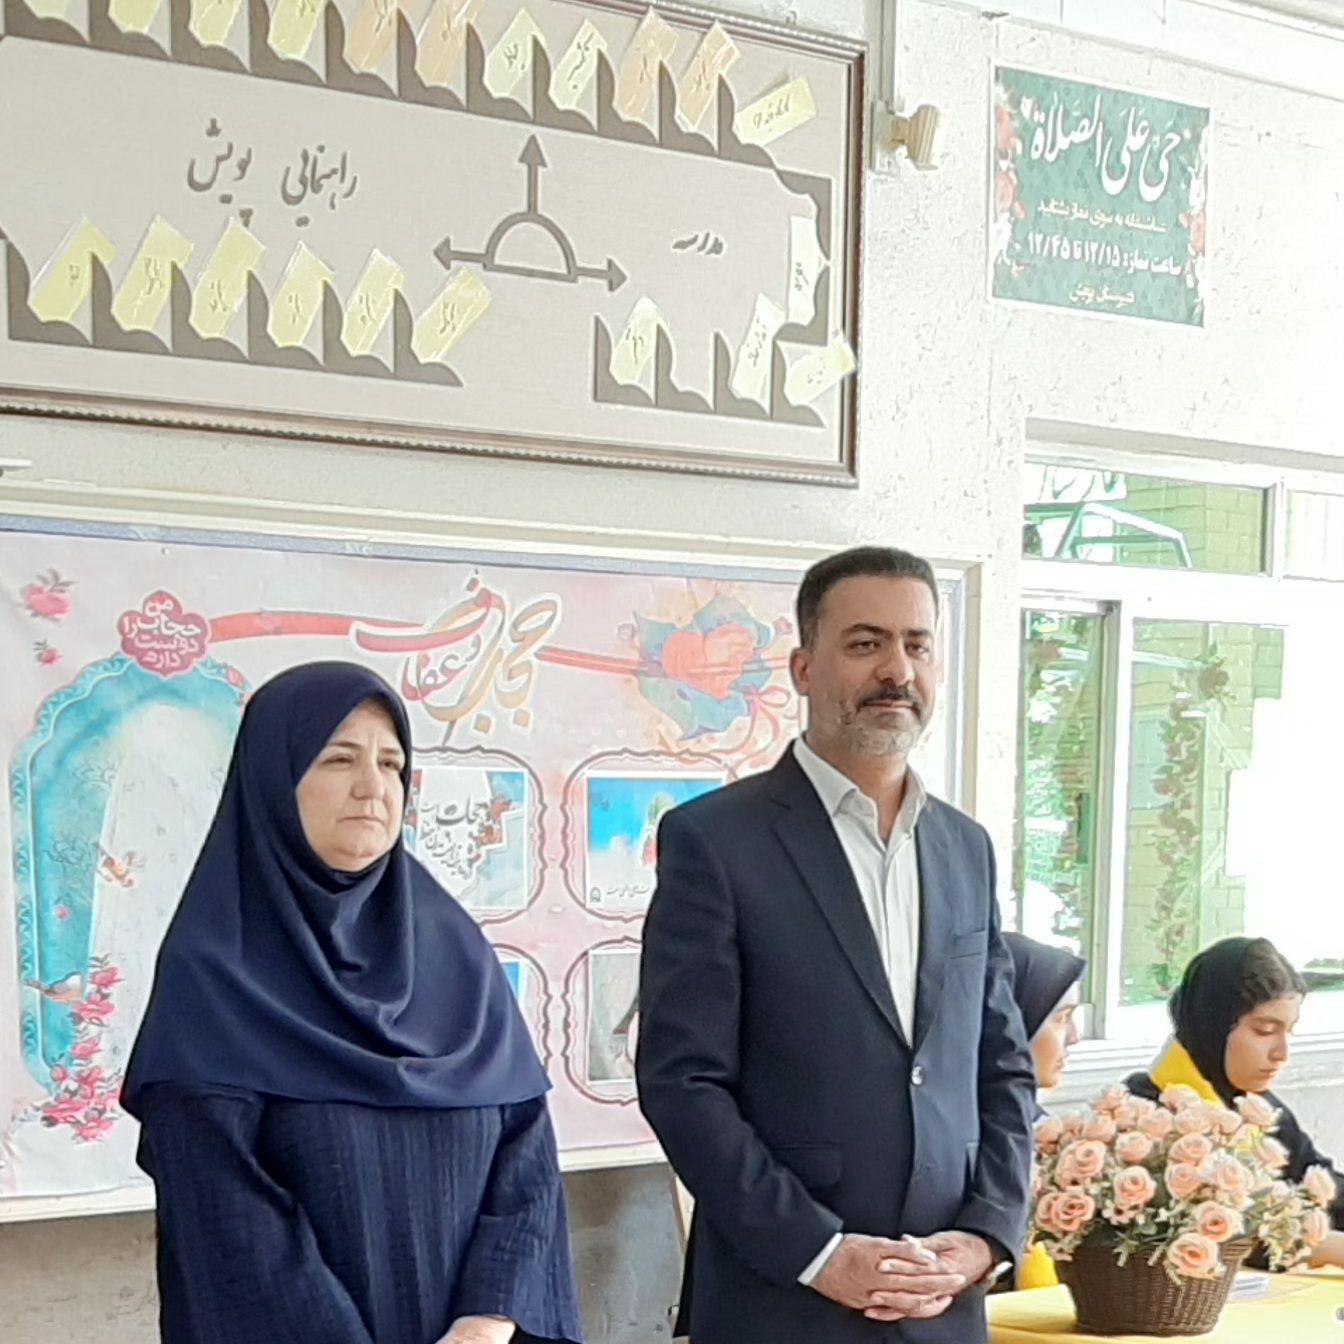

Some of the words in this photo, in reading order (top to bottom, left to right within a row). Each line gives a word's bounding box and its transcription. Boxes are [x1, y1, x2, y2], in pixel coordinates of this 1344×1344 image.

[186, 117, 253, 228] پویش
[1150, 255, 1182, 276] ساعت
[144, 599, 174, 617] من
[124, 616, 138, 638] را
[136, 613, 201, 635] حجاب
[134, 634, 199, 655] دوست
[142, 650, 180, 668] دارم
